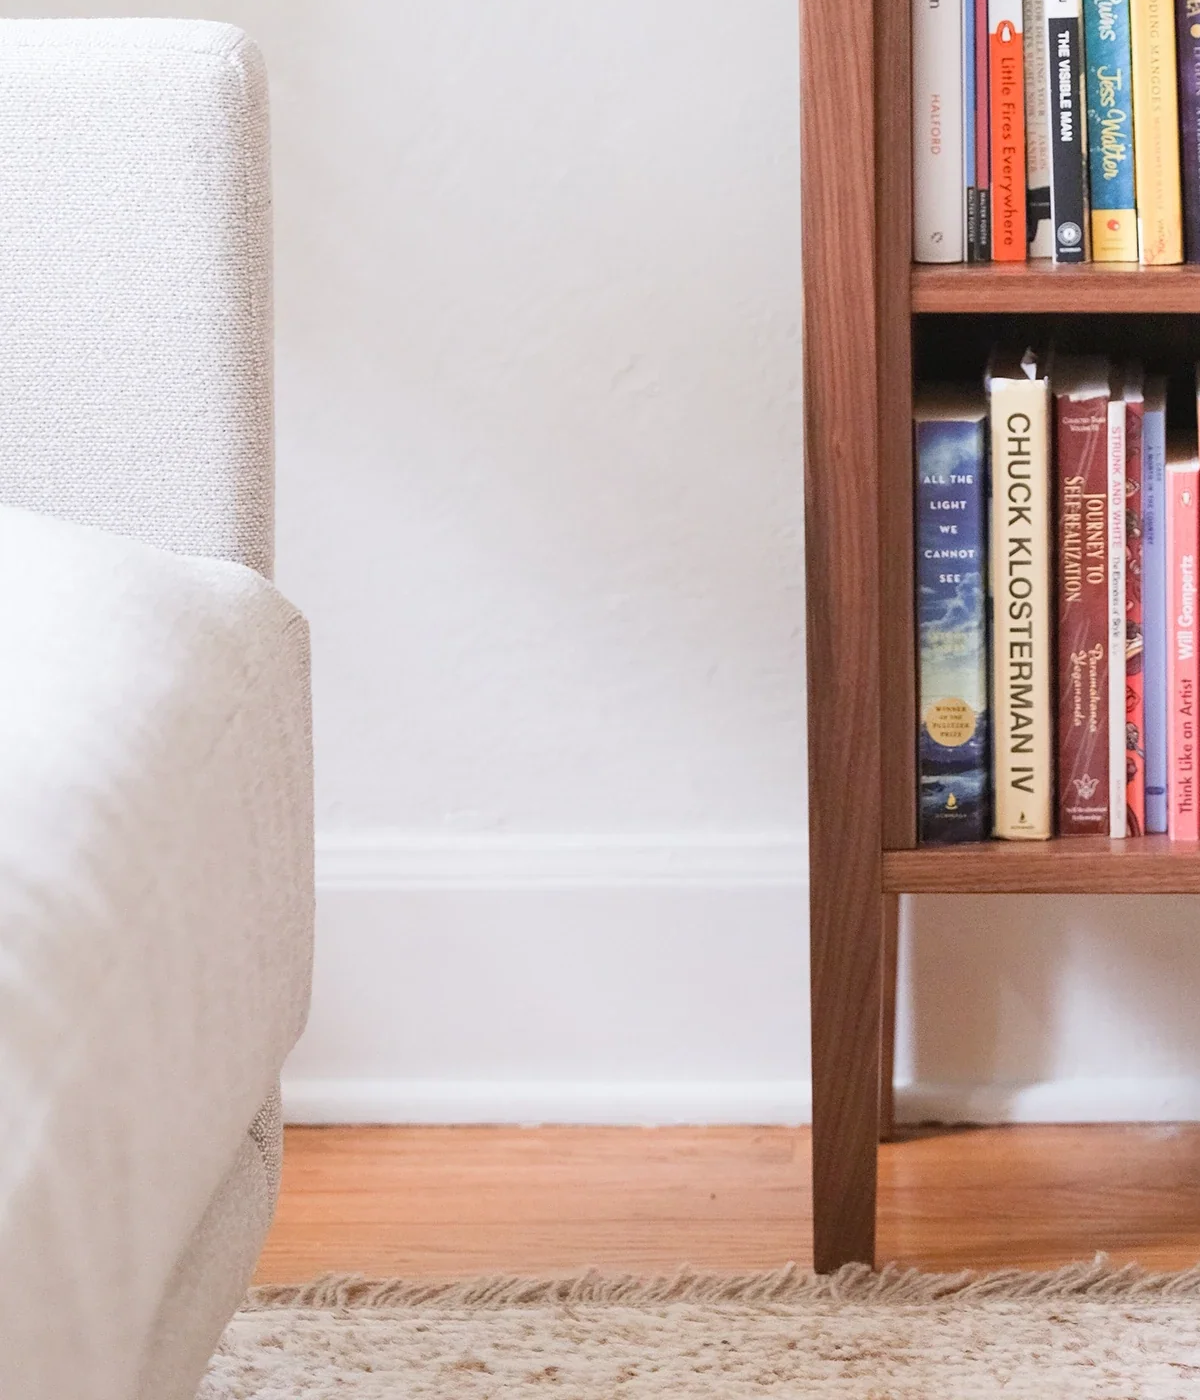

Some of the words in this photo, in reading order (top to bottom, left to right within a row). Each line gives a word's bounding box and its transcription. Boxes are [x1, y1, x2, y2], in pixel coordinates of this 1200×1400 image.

[1057, 30, 1070, 57] THE
[1001, 56, 1016, 95] Little
[1058, 59, 1072, 109] VISIBLE
[1096, 65, 1123, 108] Jess
[930, 93, 941, 154] HALFORD
[1002, 103, 1015, 140] Fires
[1060, 111, 1073, 142] MAN
[1100, 109, 1128, 180] Walter
[1000, 147, 1018, 246] Everywhere
[1111, 426, 1121, 475] STRUNK
[923, 475, 947, 485] ALL
[949, 474, 974, 485] THE
[1007, 412, 1032, 527] CHUCK
[930, 500, 968, 511] LIGHT
[1112, 479, 1121, 505] AND
[939, 525, 960, 535] WE
[1063, 474, 1085, 603] SELF-REALIZATION
[1081, 492, 1108, 560] JOURNEY
[1112, 509, 1122, 549] WHITE
[924, 549, 976, 560] CANNOT
[939, 574, 962, 584] SEE
[1086, 563, 1106, 585] TO
[1179, 555, 1197, 628] Gompertz
[1009, 537, 1036, 753] KLOSTERMAN
[1177, 631, 1194, 660] Will
[1179, 679, 1194, 716] Artist
[1179, 721, 1193, 740] an
[1178, 744, 1194, 771] Like
[1010, 765, 1035, 794] IV
[1178, 776, 1194, 815] Think
